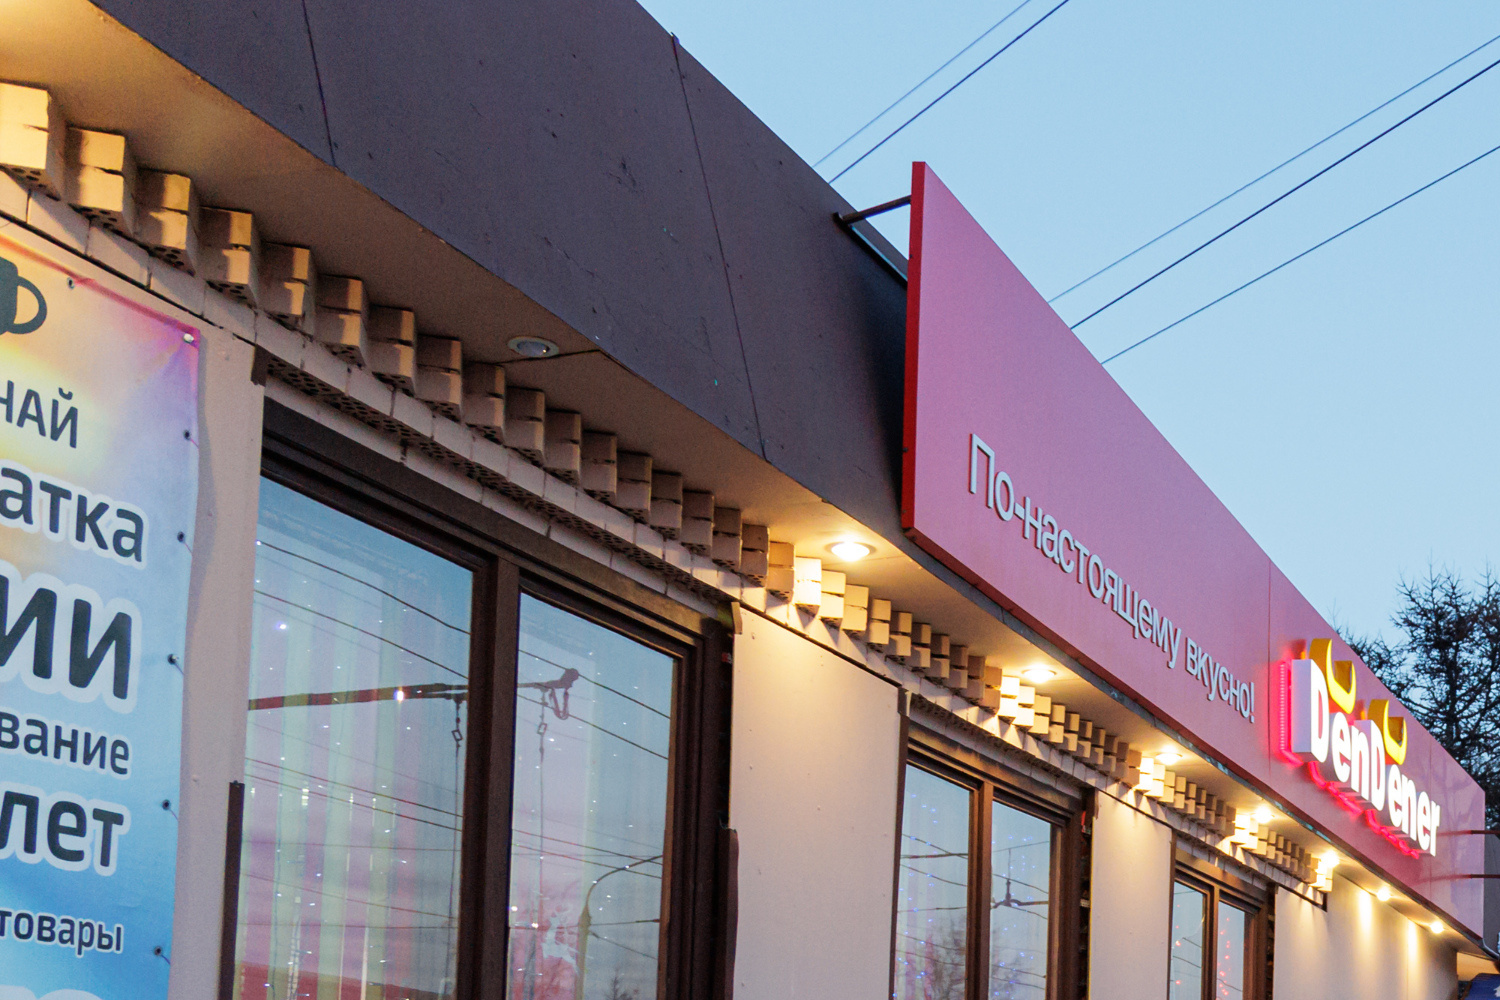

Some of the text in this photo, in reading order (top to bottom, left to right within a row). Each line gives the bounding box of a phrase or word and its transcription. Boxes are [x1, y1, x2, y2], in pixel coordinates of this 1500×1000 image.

[0, 467, 144, 563] атка
[969, 433, 1255, 724] По-настоящему вкусно!
[0, 711, 129, 775] вание
[1292, 657, 1441, 858] DenDener
[0, 790, 124, 867] лет
